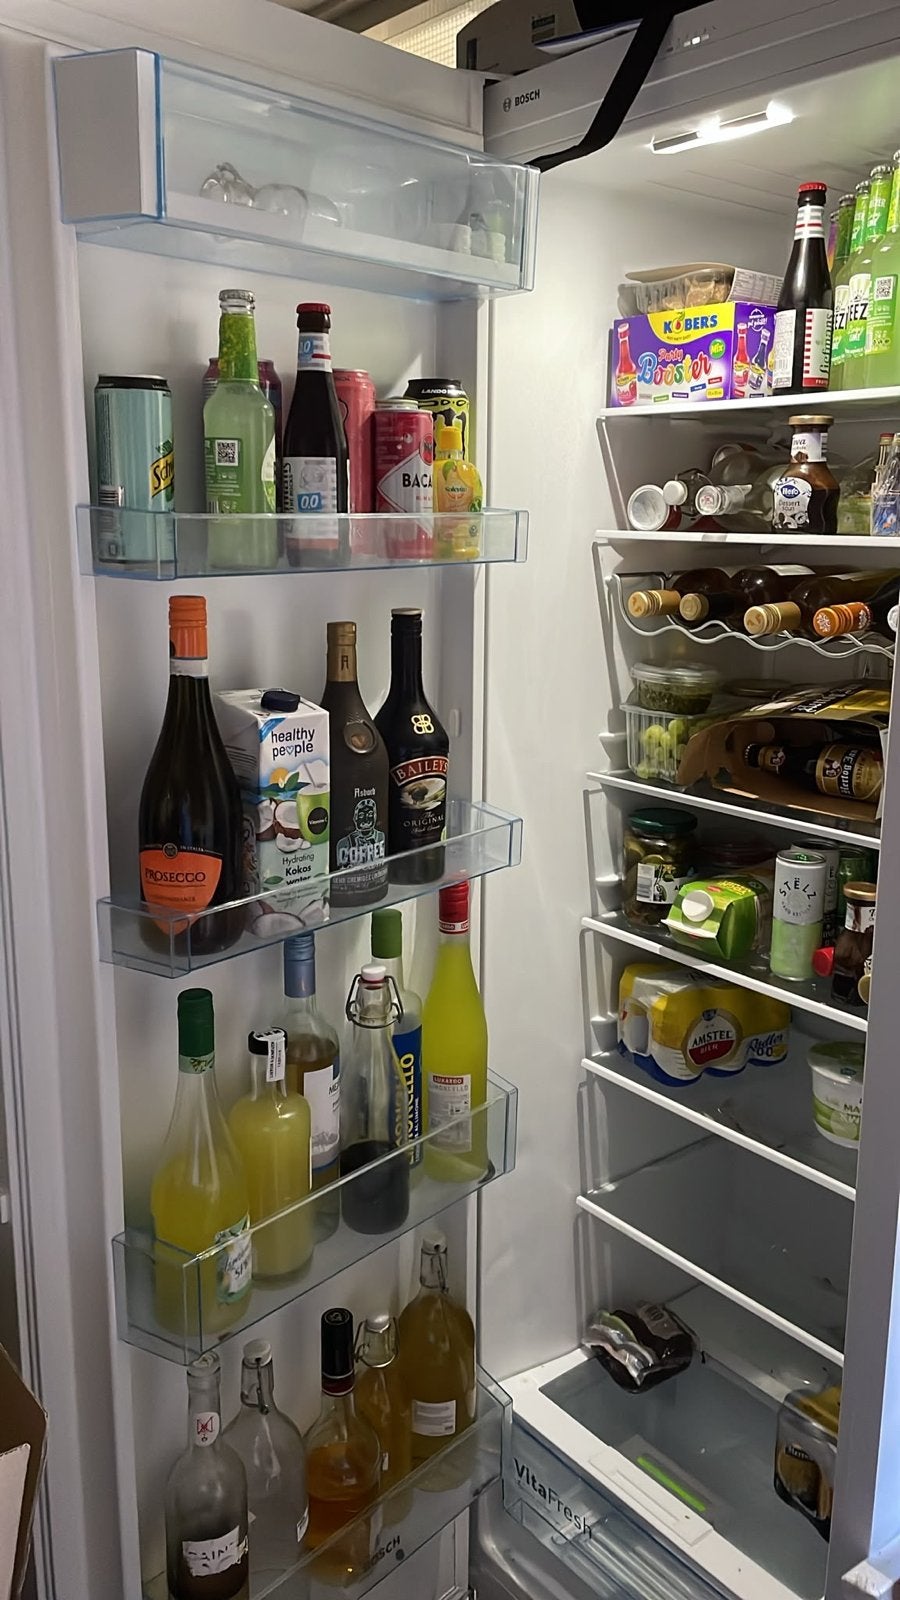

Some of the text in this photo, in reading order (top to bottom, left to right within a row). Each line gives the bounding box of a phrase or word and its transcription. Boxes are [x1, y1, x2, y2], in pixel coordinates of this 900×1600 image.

[514, 89, 541, 106] BOSCH
[658, 348, 683, 362] Party
[637, 351, 711, 386] Booster
[779, 500, 801, 508] Dessert
[271, 727, 315, 743] healthy
[396, 760, 449, 780] BAILEYS
[282, 853, 315, 866] Hydrating
[340, 841, 385, 864] COFFEE
[145, 868, 206, 883] PROSECCO
[285, 865, 312, 876] Kokos
[779, 877, 817, 900] STËLZ
[692, 1030, 734, 1047] AMSTEL
[700, 1043, 719, 1055] BIER
[514, 1457, 592, 1539] VitaFresh
[370, 1535, 400, 1567] OSCH
